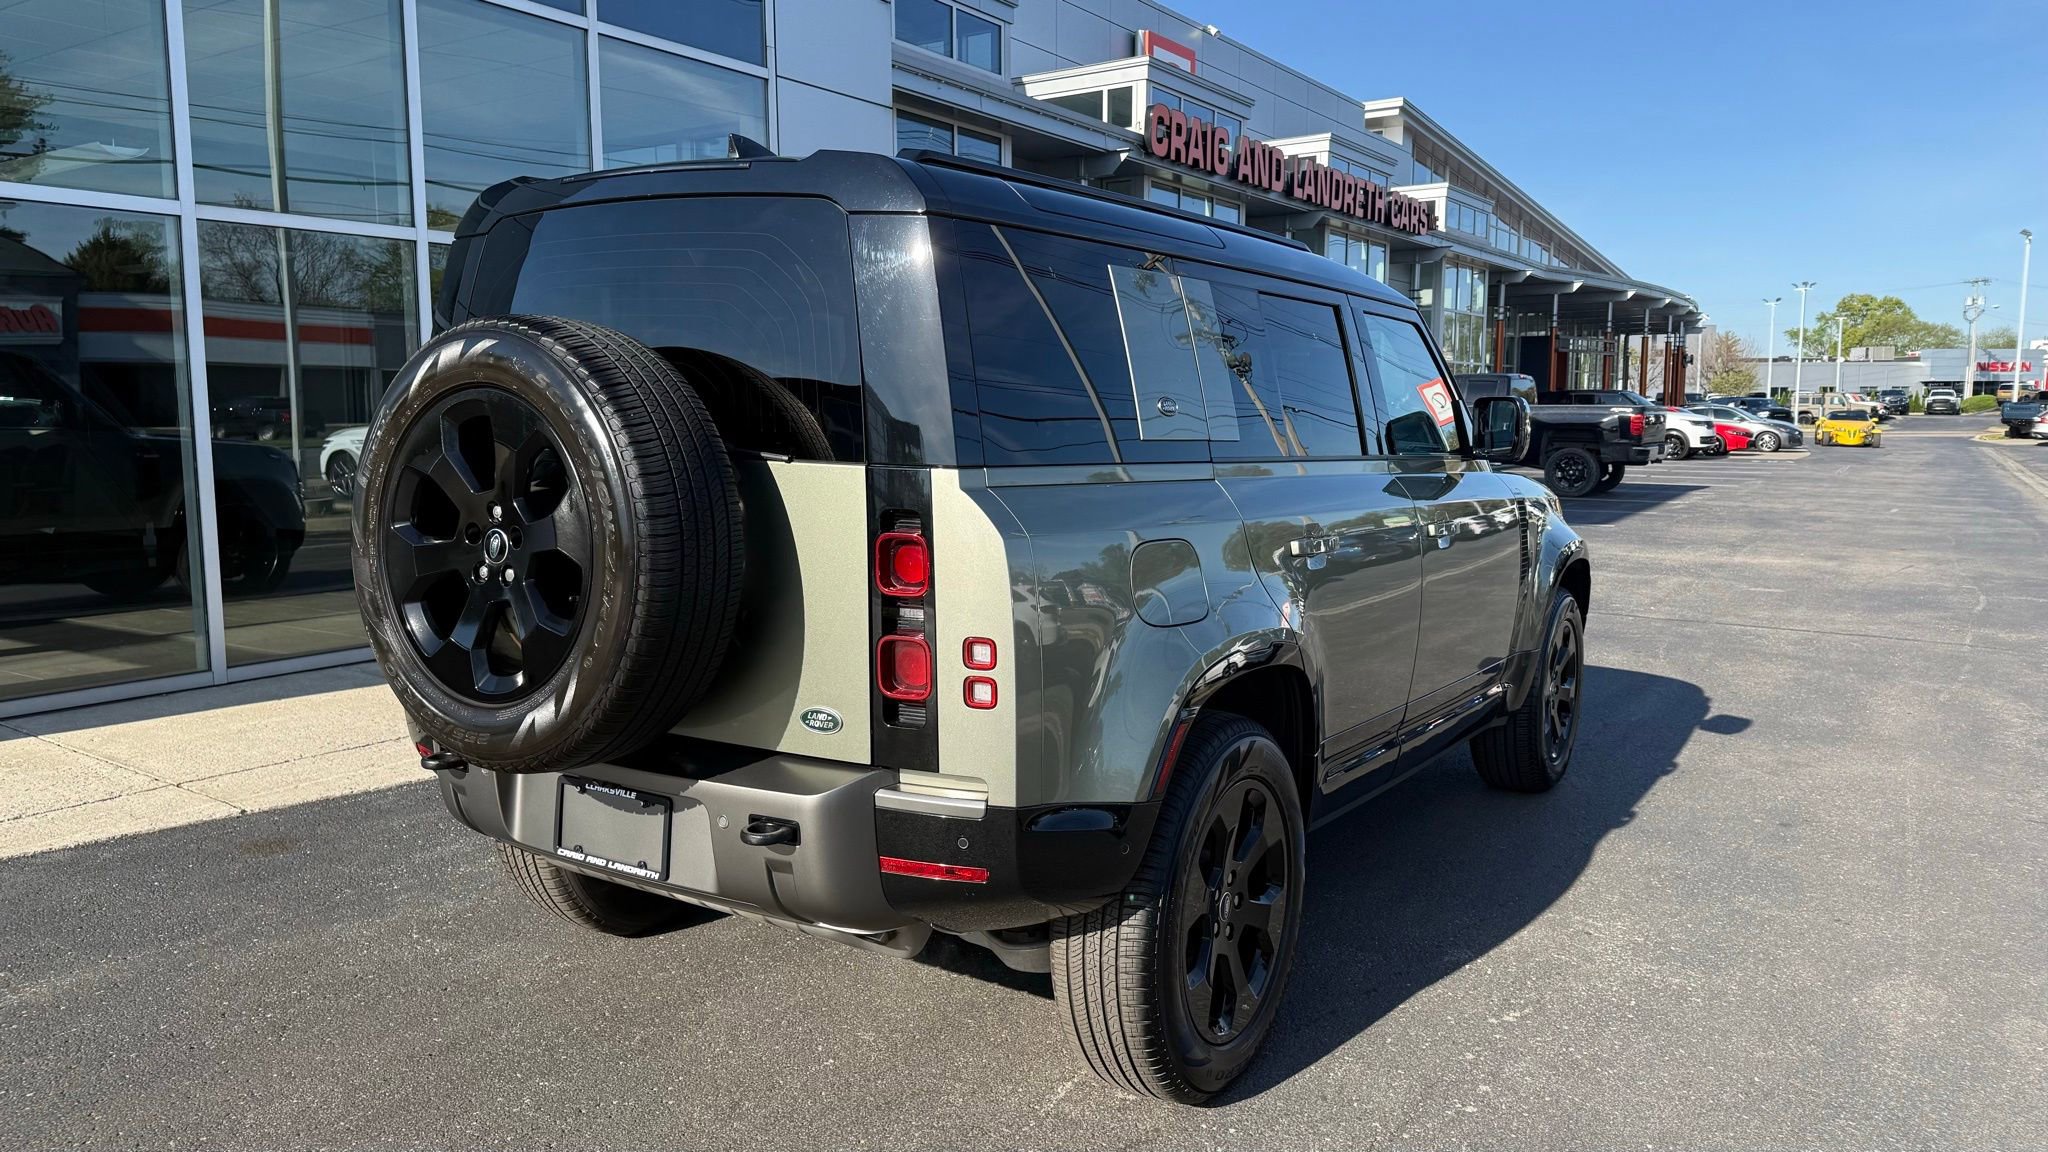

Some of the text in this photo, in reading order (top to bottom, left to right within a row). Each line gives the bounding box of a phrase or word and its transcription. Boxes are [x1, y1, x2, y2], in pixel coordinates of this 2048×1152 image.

[1149, 102, 1230, 176] CRAIG
[1237, 135, 1286, 193] AND
[1292, 159, 1386, 224] LANDRETH
[1391, 190, 1428, 236] CARS
[1975, 361, 2033, 373] NISSAN
[807, 711, 828, 721] LAND
[809, 719, 834, 729] ROVER
